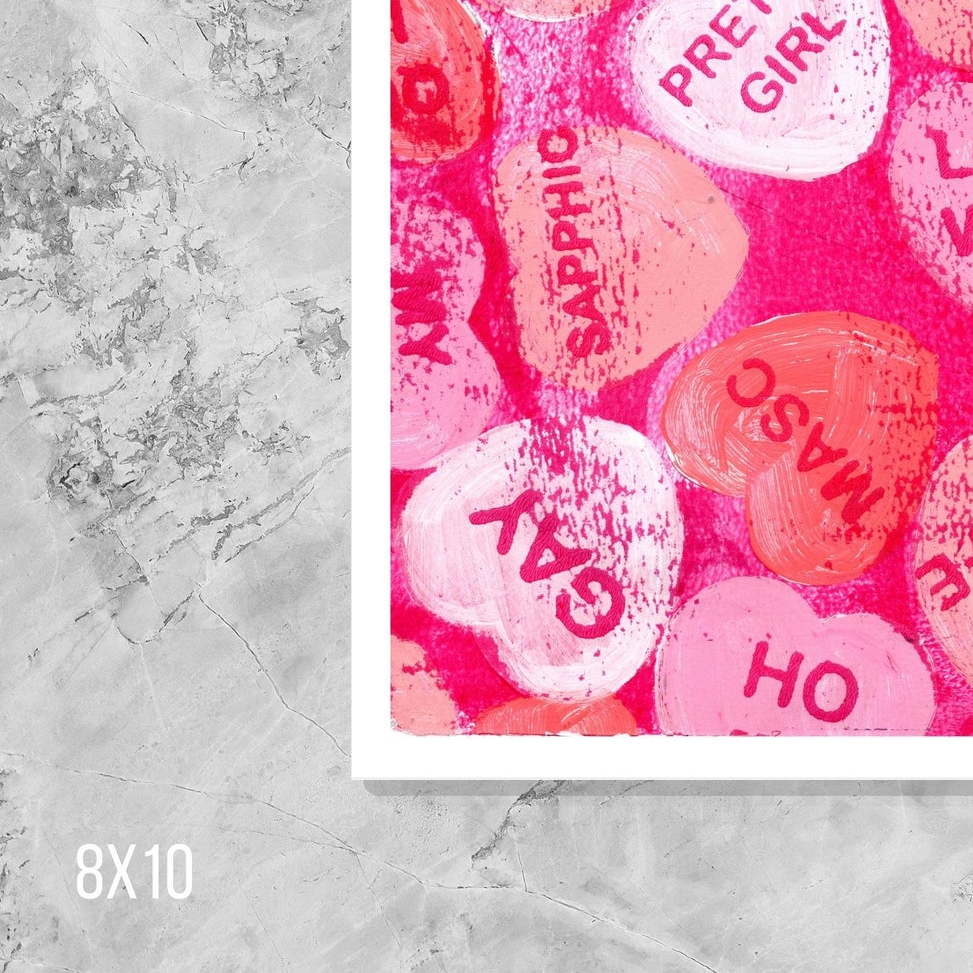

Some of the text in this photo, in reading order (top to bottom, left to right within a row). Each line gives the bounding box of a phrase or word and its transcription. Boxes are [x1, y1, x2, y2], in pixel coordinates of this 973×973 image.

[740, 12, 847, 114] GIRL
[537, 127, 612, 357] SAPPHIC
[727, 358, 884, 523] MASC
[470, 489, 626, 639] GAY
[744, 641, 859, 723] HO
